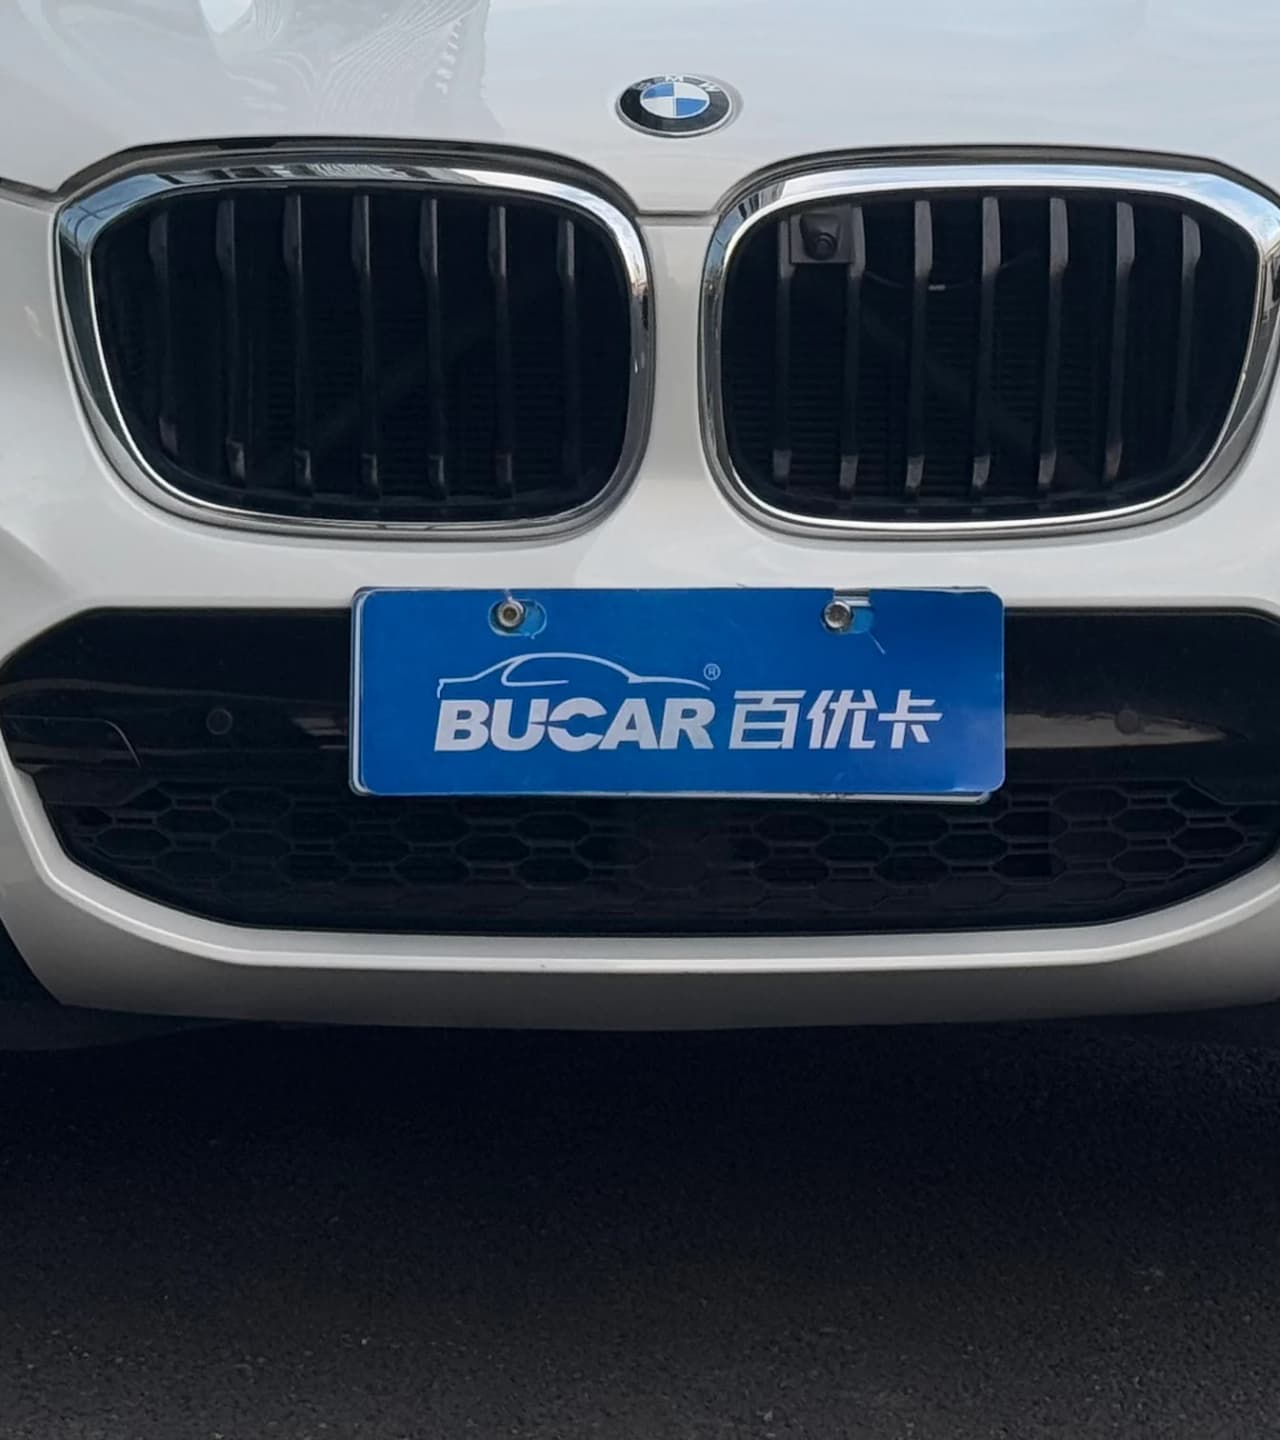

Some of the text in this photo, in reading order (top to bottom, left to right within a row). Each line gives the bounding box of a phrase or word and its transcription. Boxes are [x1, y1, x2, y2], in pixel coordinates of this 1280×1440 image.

[434, 688, 944, 753] BUCAR 百优卡
